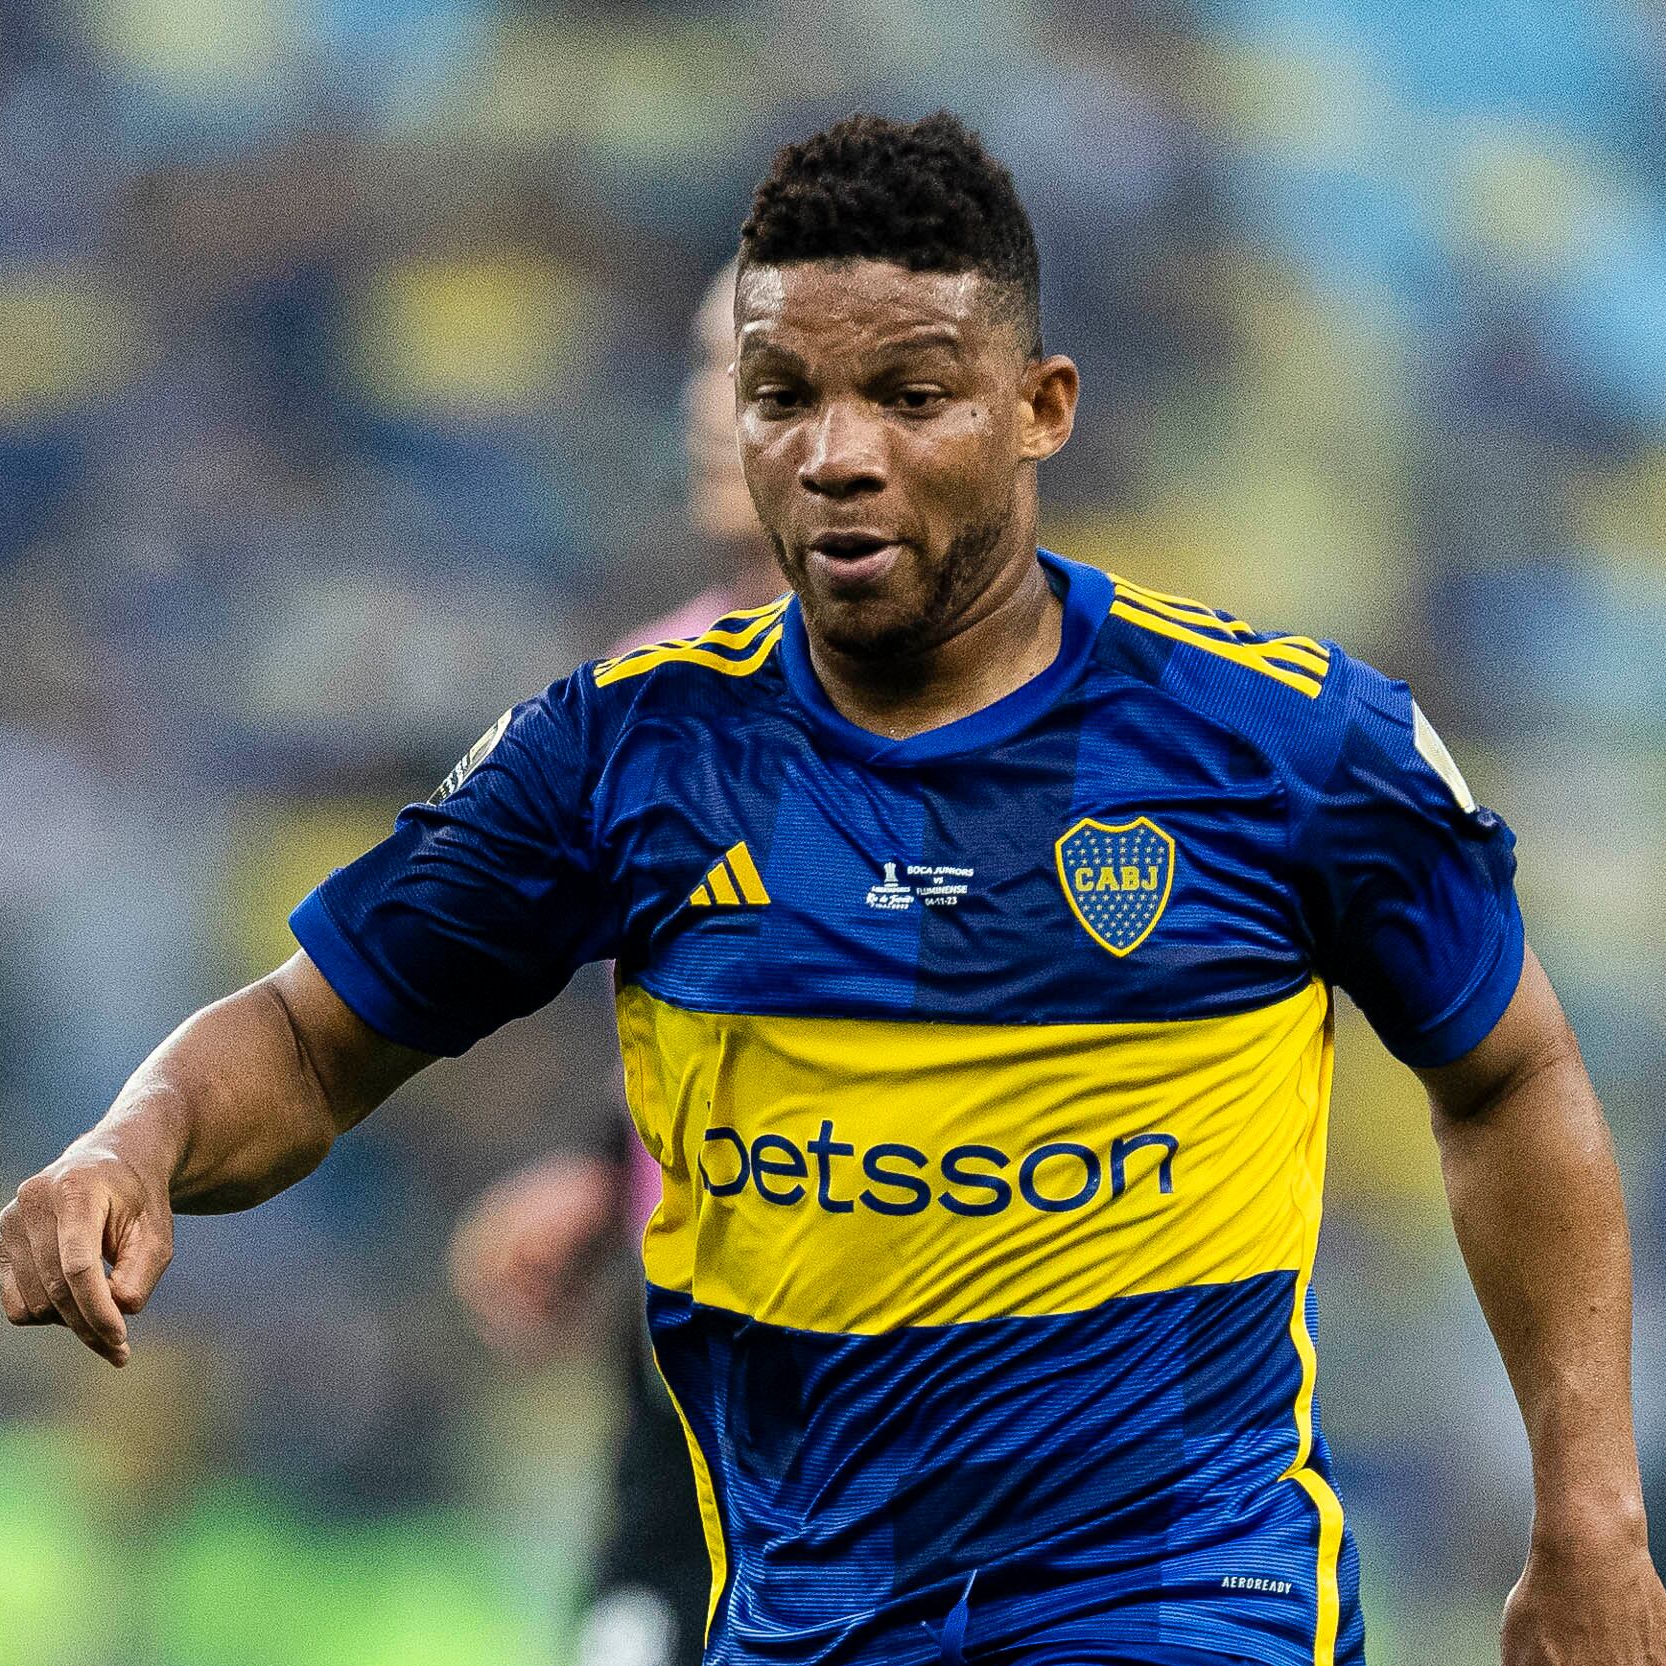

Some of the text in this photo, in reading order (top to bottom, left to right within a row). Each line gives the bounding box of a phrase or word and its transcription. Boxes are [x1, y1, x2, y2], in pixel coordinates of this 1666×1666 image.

[907, 865, 933, 875] BOCA
[1075, 866, 1159, 892] CABJ
[697, 1101, 1180, 1217] betsson
[1221, 1576, 1292, 1595] AEROREADY
